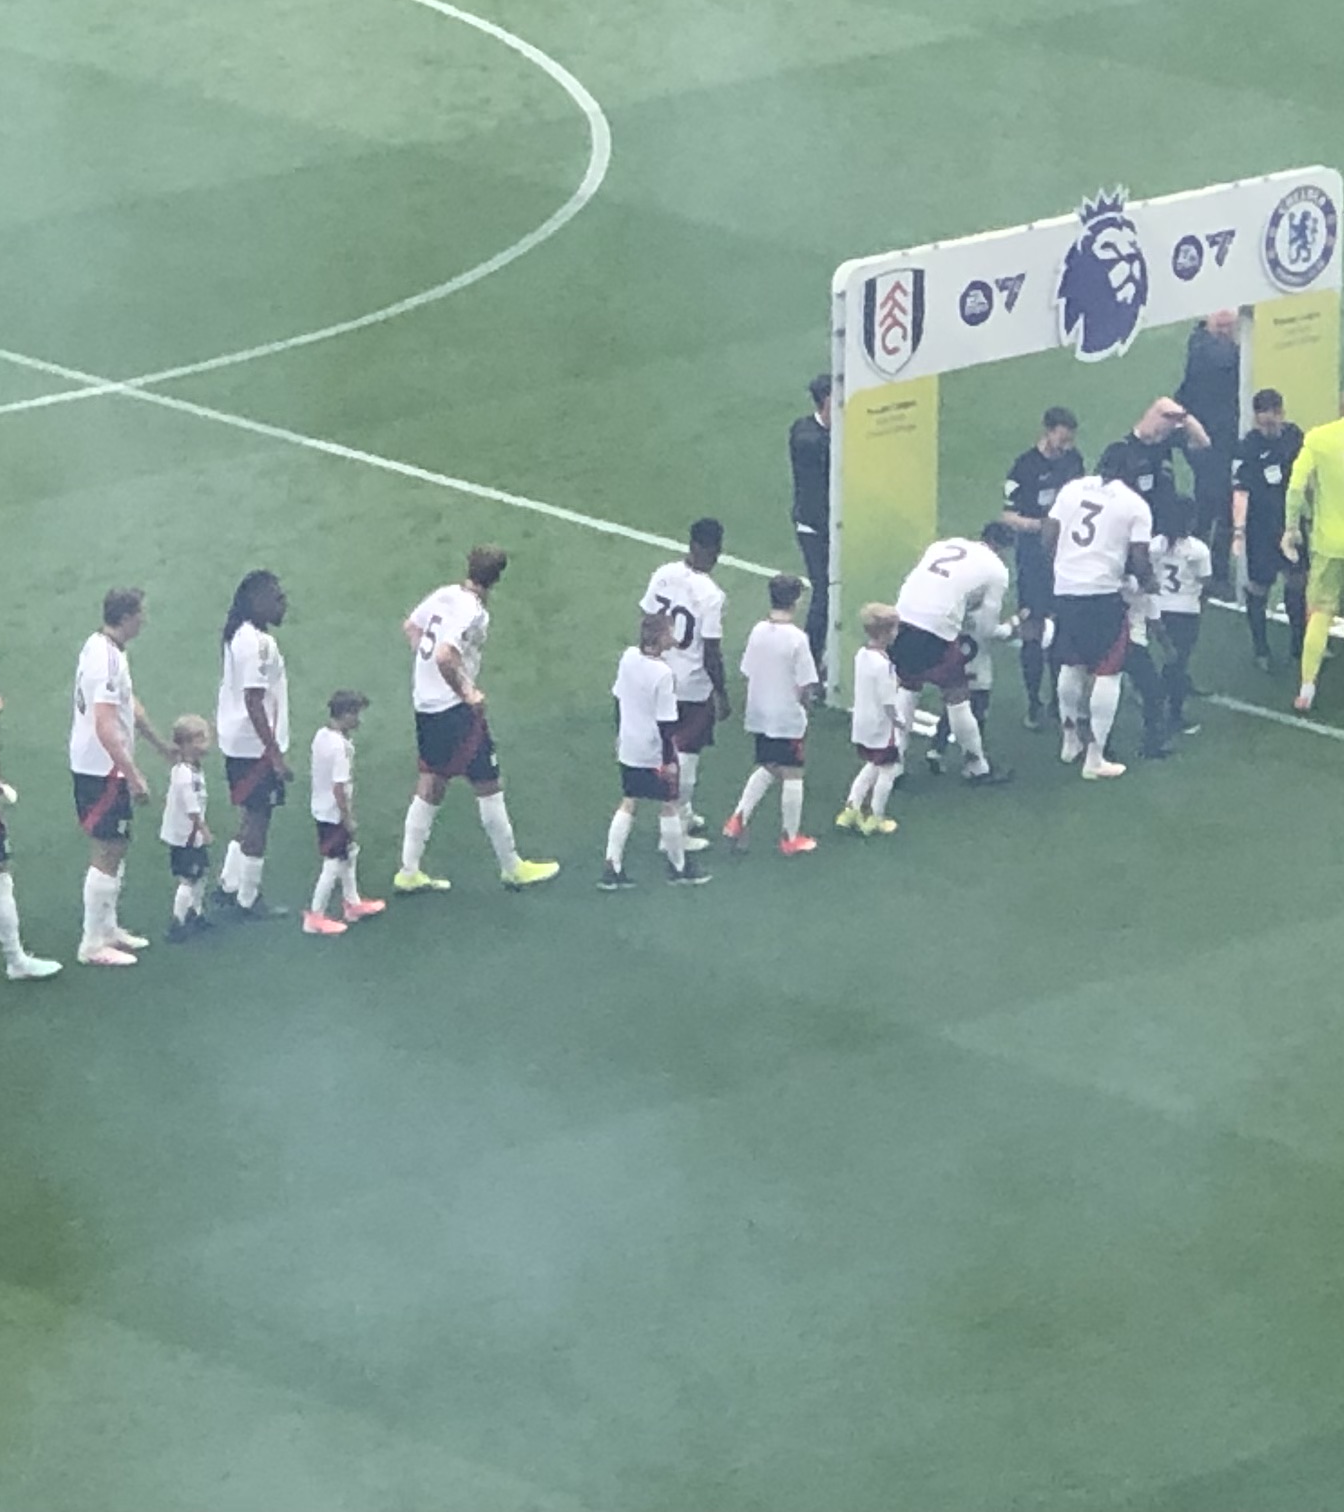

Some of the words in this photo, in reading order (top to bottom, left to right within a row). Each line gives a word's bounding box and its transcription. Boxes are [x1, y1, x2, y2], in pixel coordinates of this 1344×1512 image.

[878, 280, 908, 356] FFC
[1071, 499, 1103, 548] 3
[927, 544, 967, 578] 2
[1160, 563, 1182, 594] 3
[420, 614, 443, 661] 5
